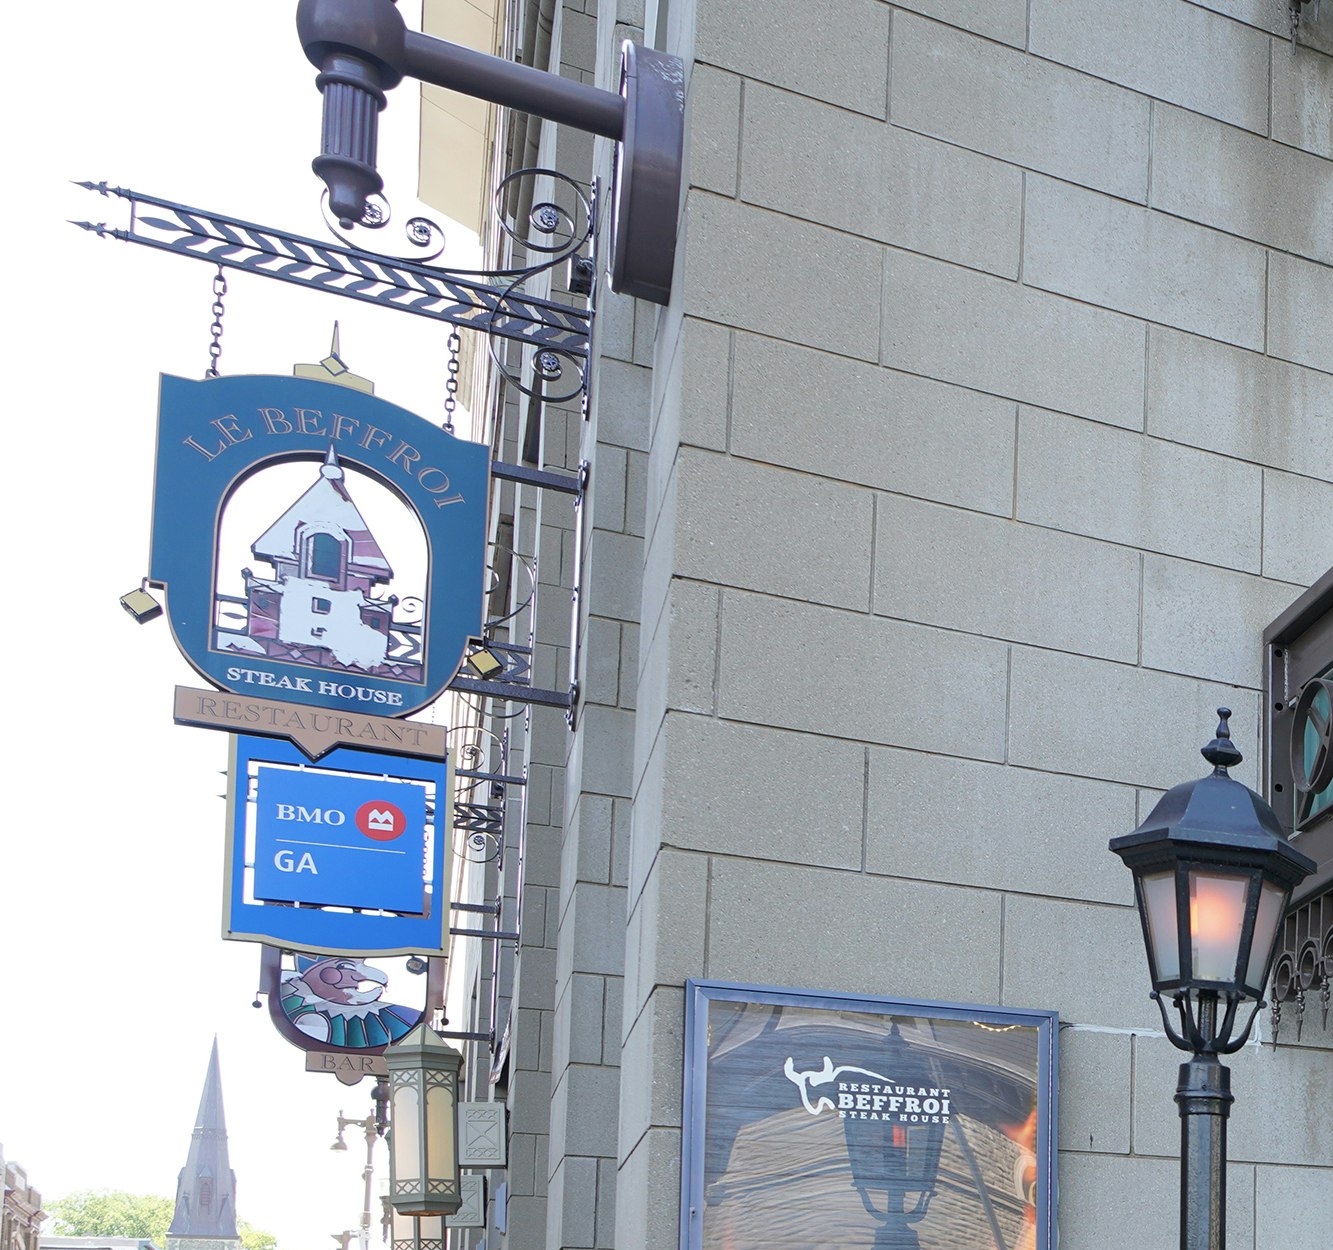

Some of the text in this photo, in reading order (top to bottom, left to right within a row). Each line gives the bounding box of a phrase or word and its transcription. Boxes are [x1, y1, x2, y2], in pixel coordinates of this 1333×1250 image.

[182, 406, 466, 509] LE BEFFROI
[226, 667, 404, 706] STEAK HOUSE
[195, 696, 429, 747] RESTAURANT
[275, 803, 346, 826] BMO
[273, 850, 319, 875] GA
[320, 1055, 375, 1072] BAR
[838, 1082, 951, 1098] RESTAURANT
[838, 1093, 950, 1115] BEFFROI
[838, 1110, 950, 1124] STEAK HOUSE
